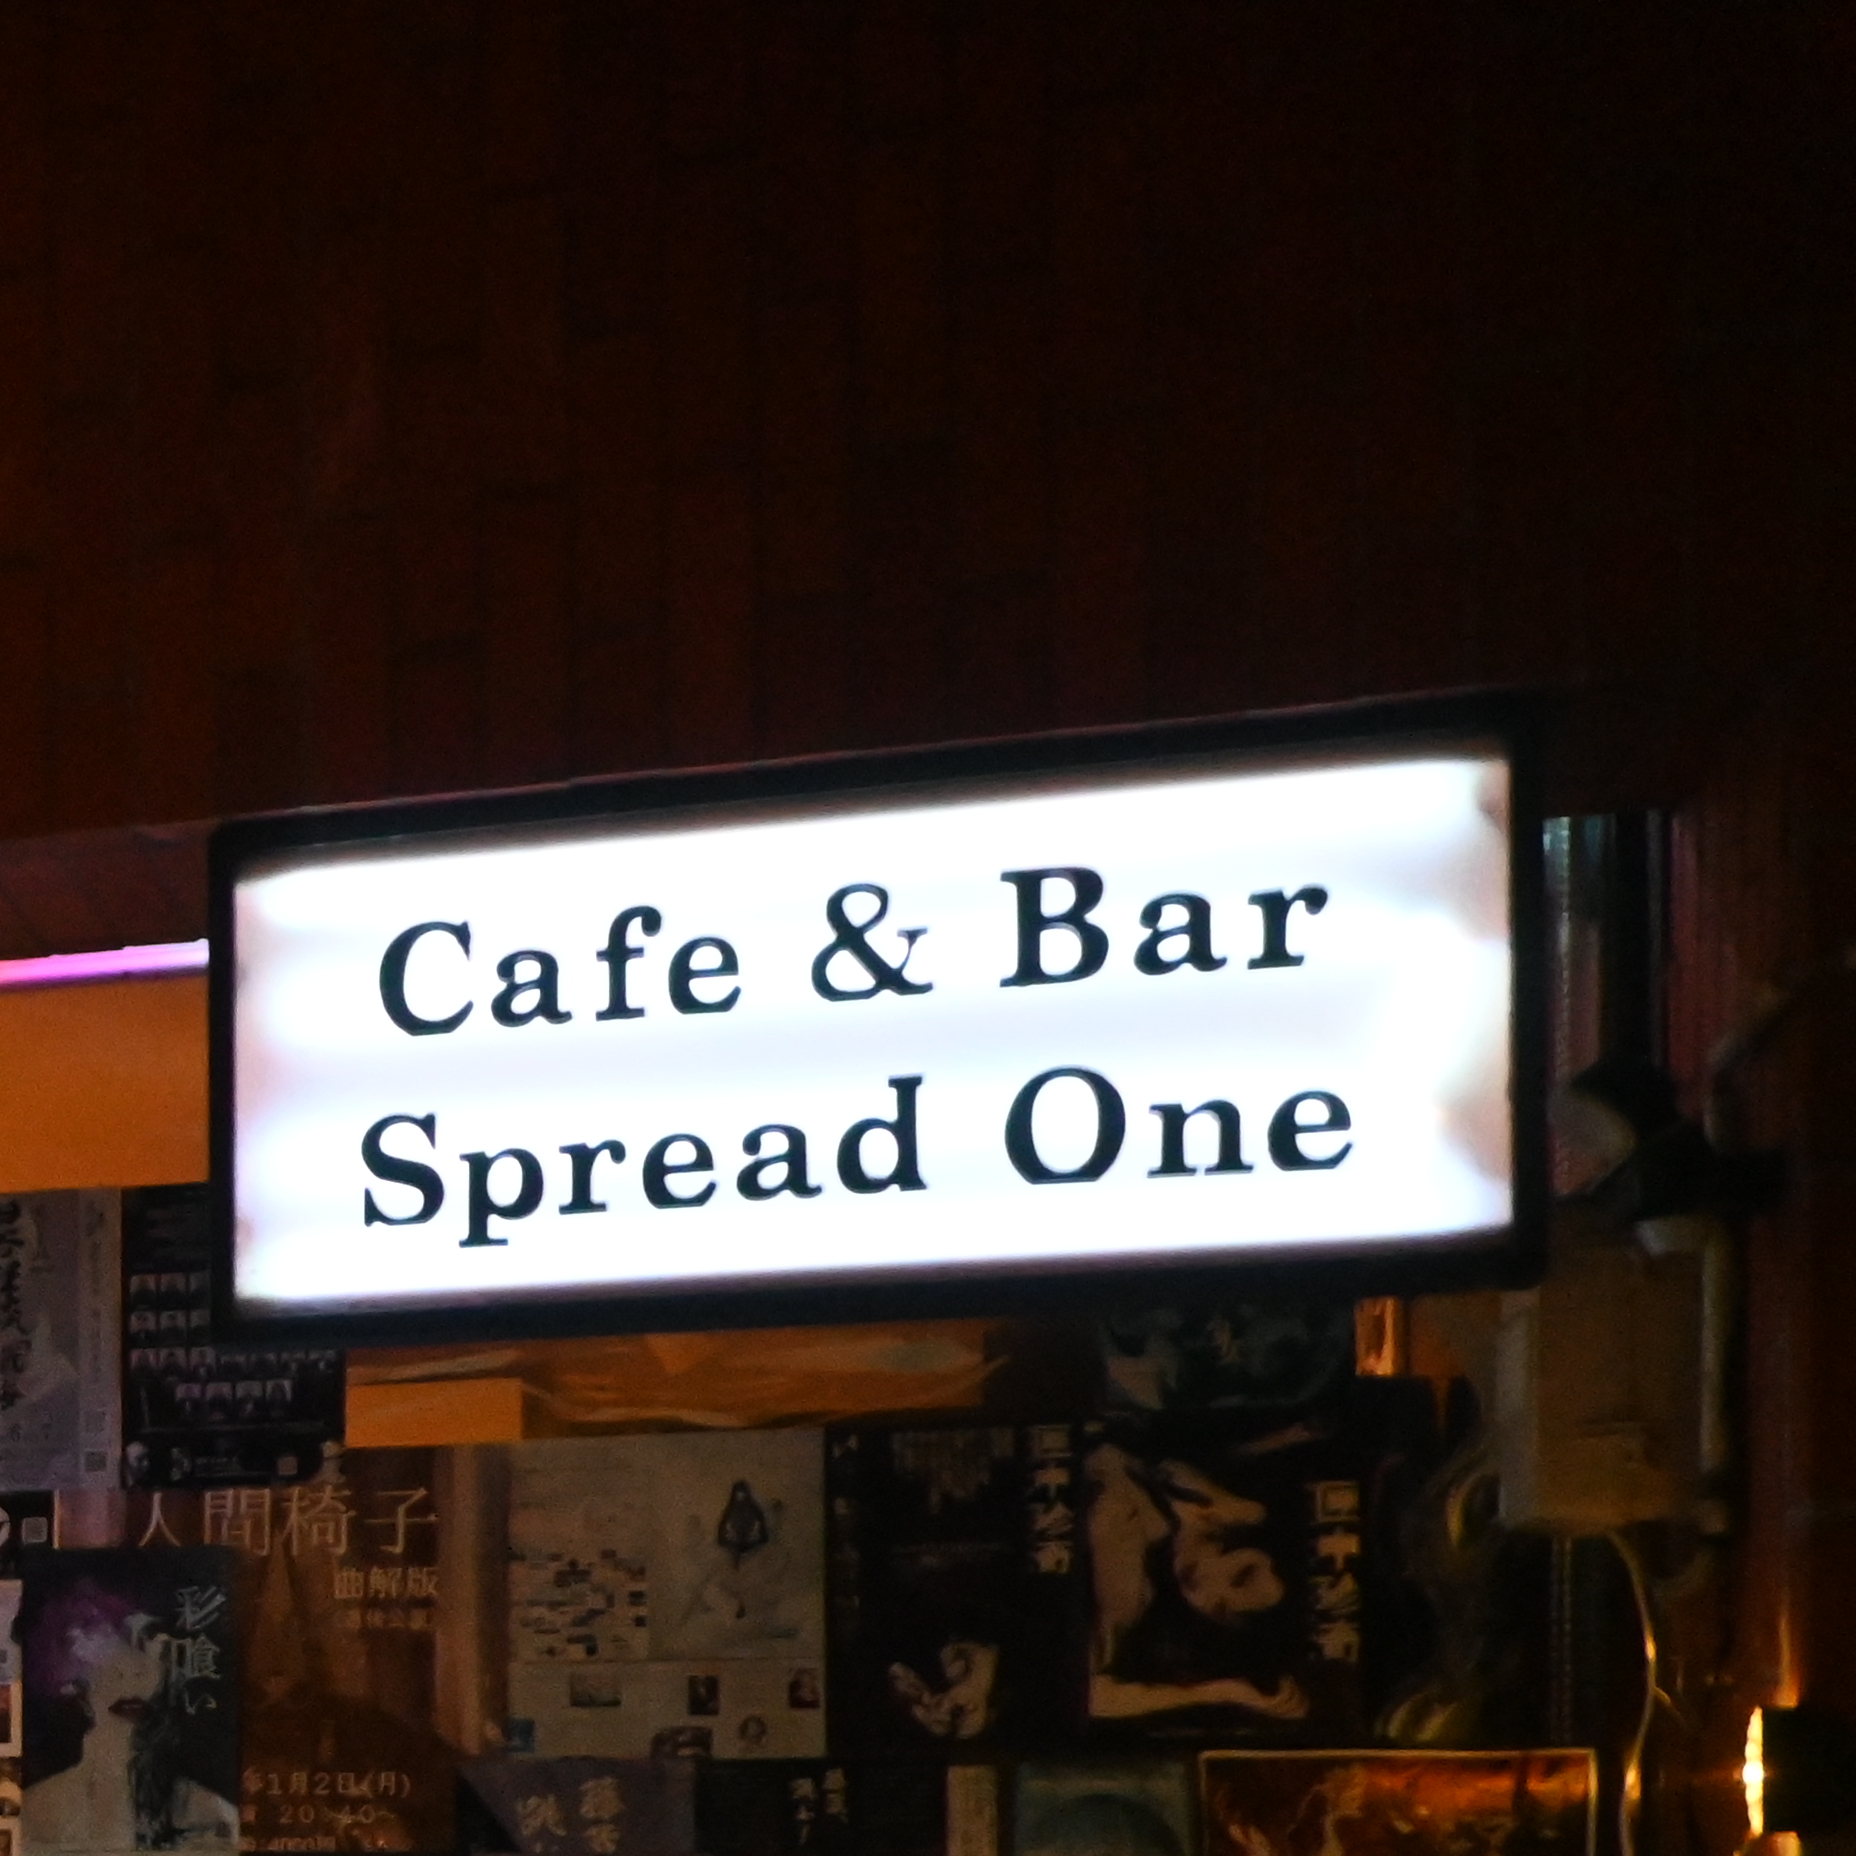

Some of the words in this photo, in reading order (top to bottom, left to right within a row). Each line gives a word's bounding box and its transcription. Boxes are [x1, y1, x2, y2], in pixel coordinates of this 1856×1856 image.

[379, 905, 743, 1036] Cafe
[811, 883, 933, 1002] &
[1000, 866, 1328, 988] Bar
[362, 1075, 928, 1247] Spread
[1006, 1066, 1355, 1185] One
[137, 1484, 439, 1557] 人間椅子
